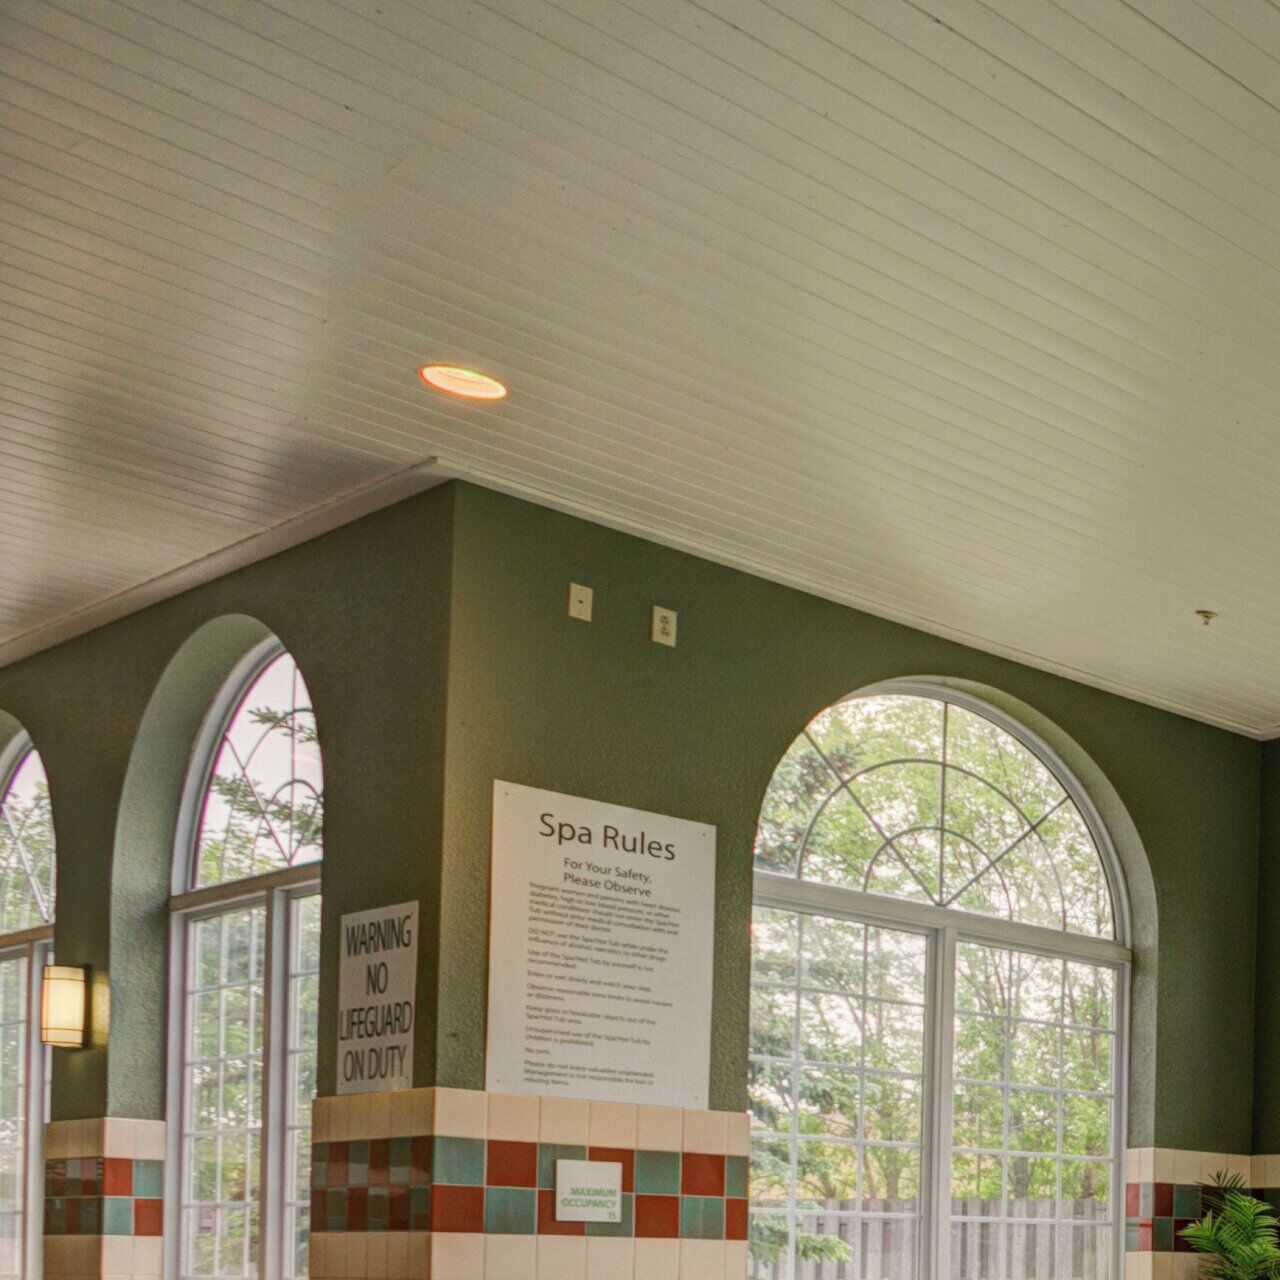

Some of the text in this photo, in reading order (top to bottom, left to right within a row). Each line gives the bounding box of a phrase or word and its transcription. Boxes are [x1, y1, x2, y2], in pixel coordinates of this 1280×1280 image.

[539, 813, 676, 861] Spa Rules
[563, 857, 653, 884] For Your Safety,
[563, 872, 652, 898] Please Observe
[345, 914, 412, 958] WARNING
[366, 961, 389, 996] NO
[339, 1001, 413, 1041] LIFEGUARD
[343, 1045, 408, 1082] ON DUTY
[562, 1199, 616, 1208] OCCUPANCY
[570, 1187, 617, 1197] MAXIMUM
